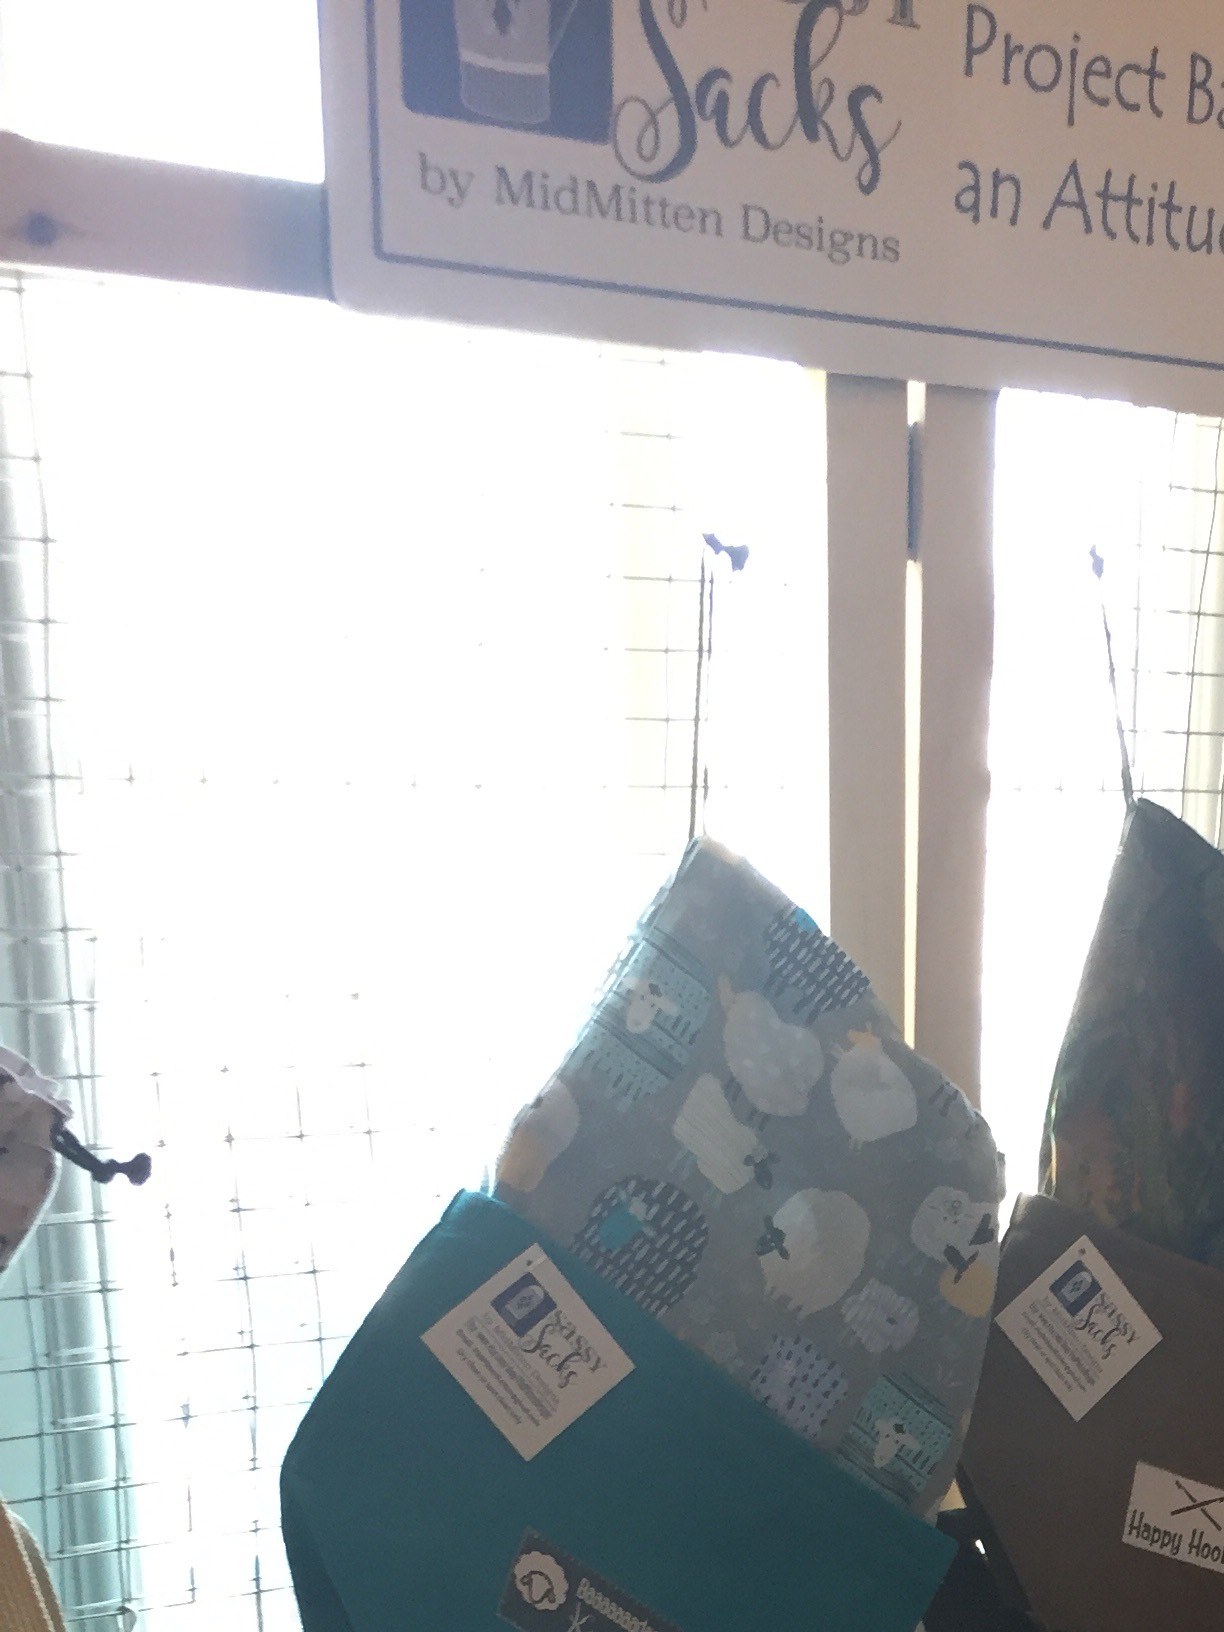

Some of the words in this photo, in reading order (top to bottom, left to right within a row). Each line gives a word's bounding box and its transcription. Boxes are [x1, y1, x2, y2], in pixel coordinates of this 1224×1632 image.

[612, 0, 902, 195] Sacks
[964, 3, 1166, 127] Project
[418, 152, 475, 207] by
[496, 165, 724, 239] MidMitten
[742, 204, 901, 266] Designs
[954, 159, 1022, 226] an
[1128, 1509, 1183, 1556] Happy
